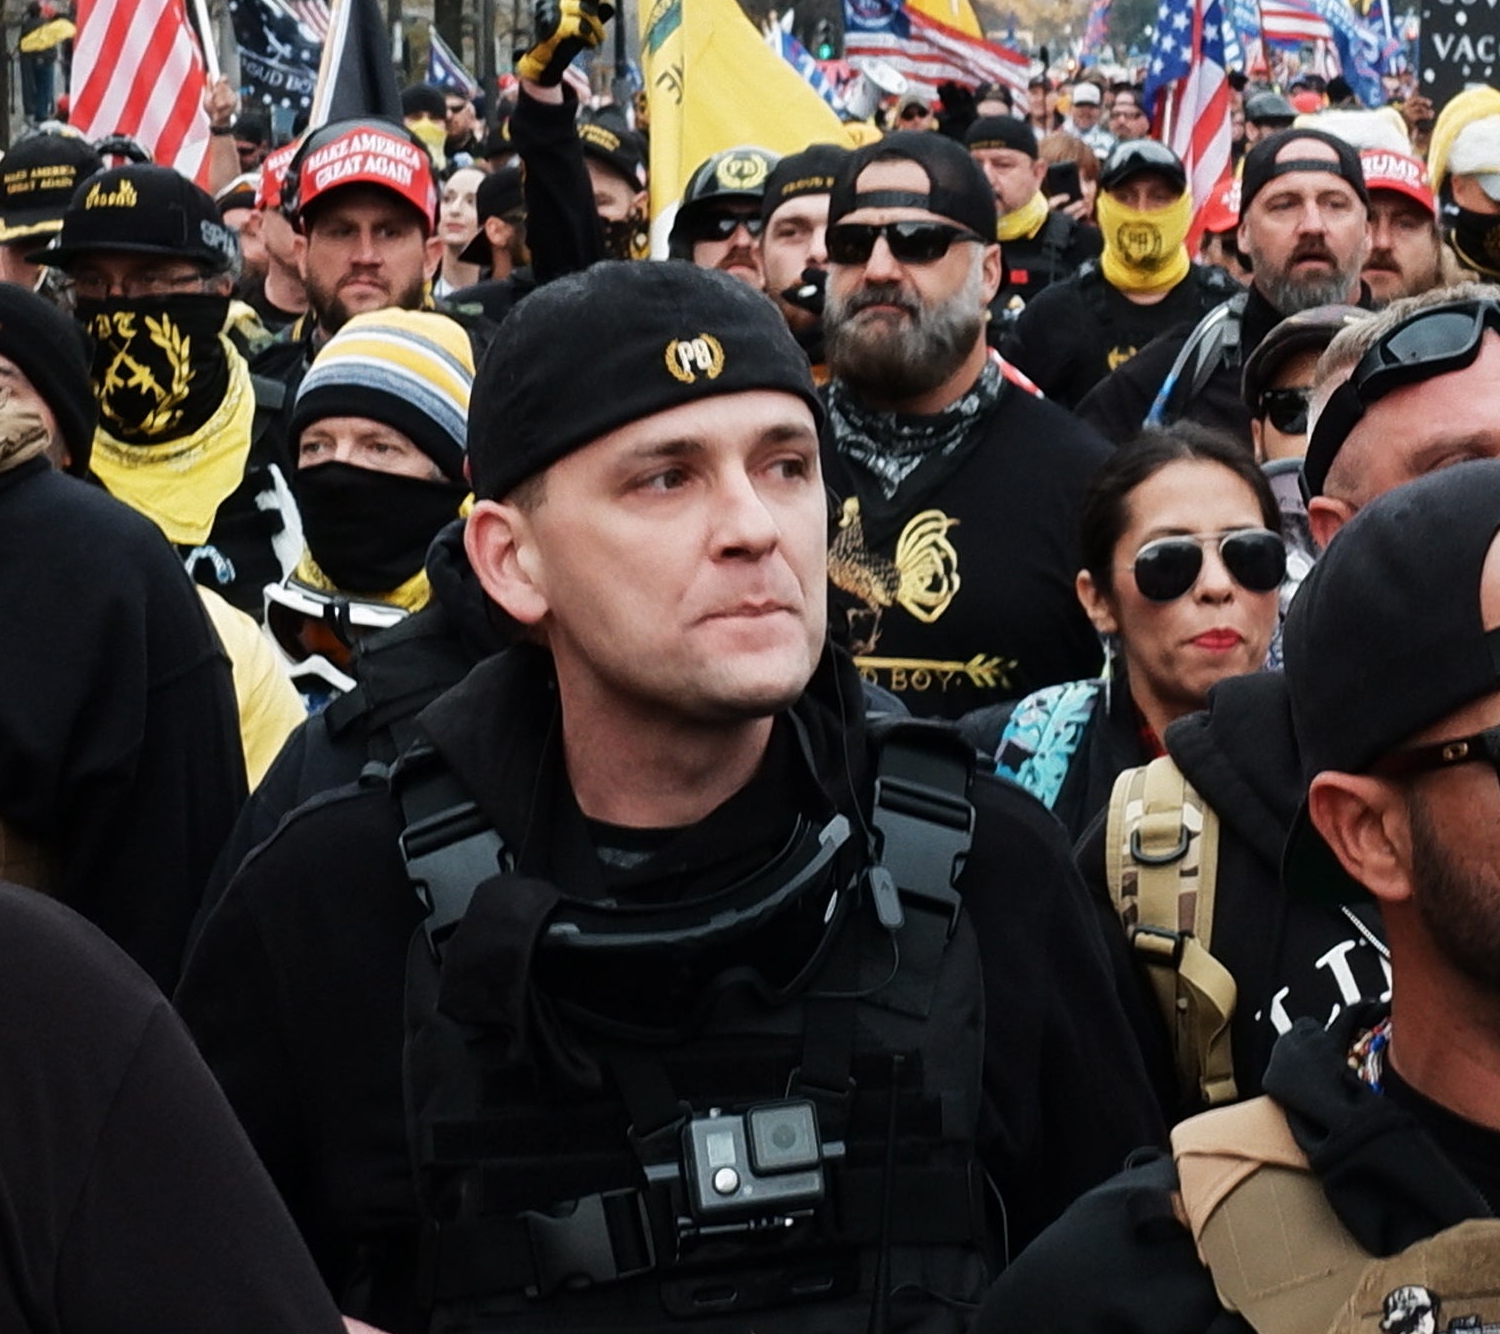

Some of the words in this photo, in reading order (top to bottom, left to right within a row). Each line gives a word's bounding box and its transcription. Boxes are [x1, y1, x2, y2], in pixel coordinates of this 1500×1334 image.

[306, 138, 350, 174] MAKE
[350, 133, 421, 171] AMERICA
[1361, 154, 1421, 183] RUMP
[315, 153, 365, 192] GREAT
[364, 153, 414, 189] AGAIN
[677, 338, 714, 374] PB
